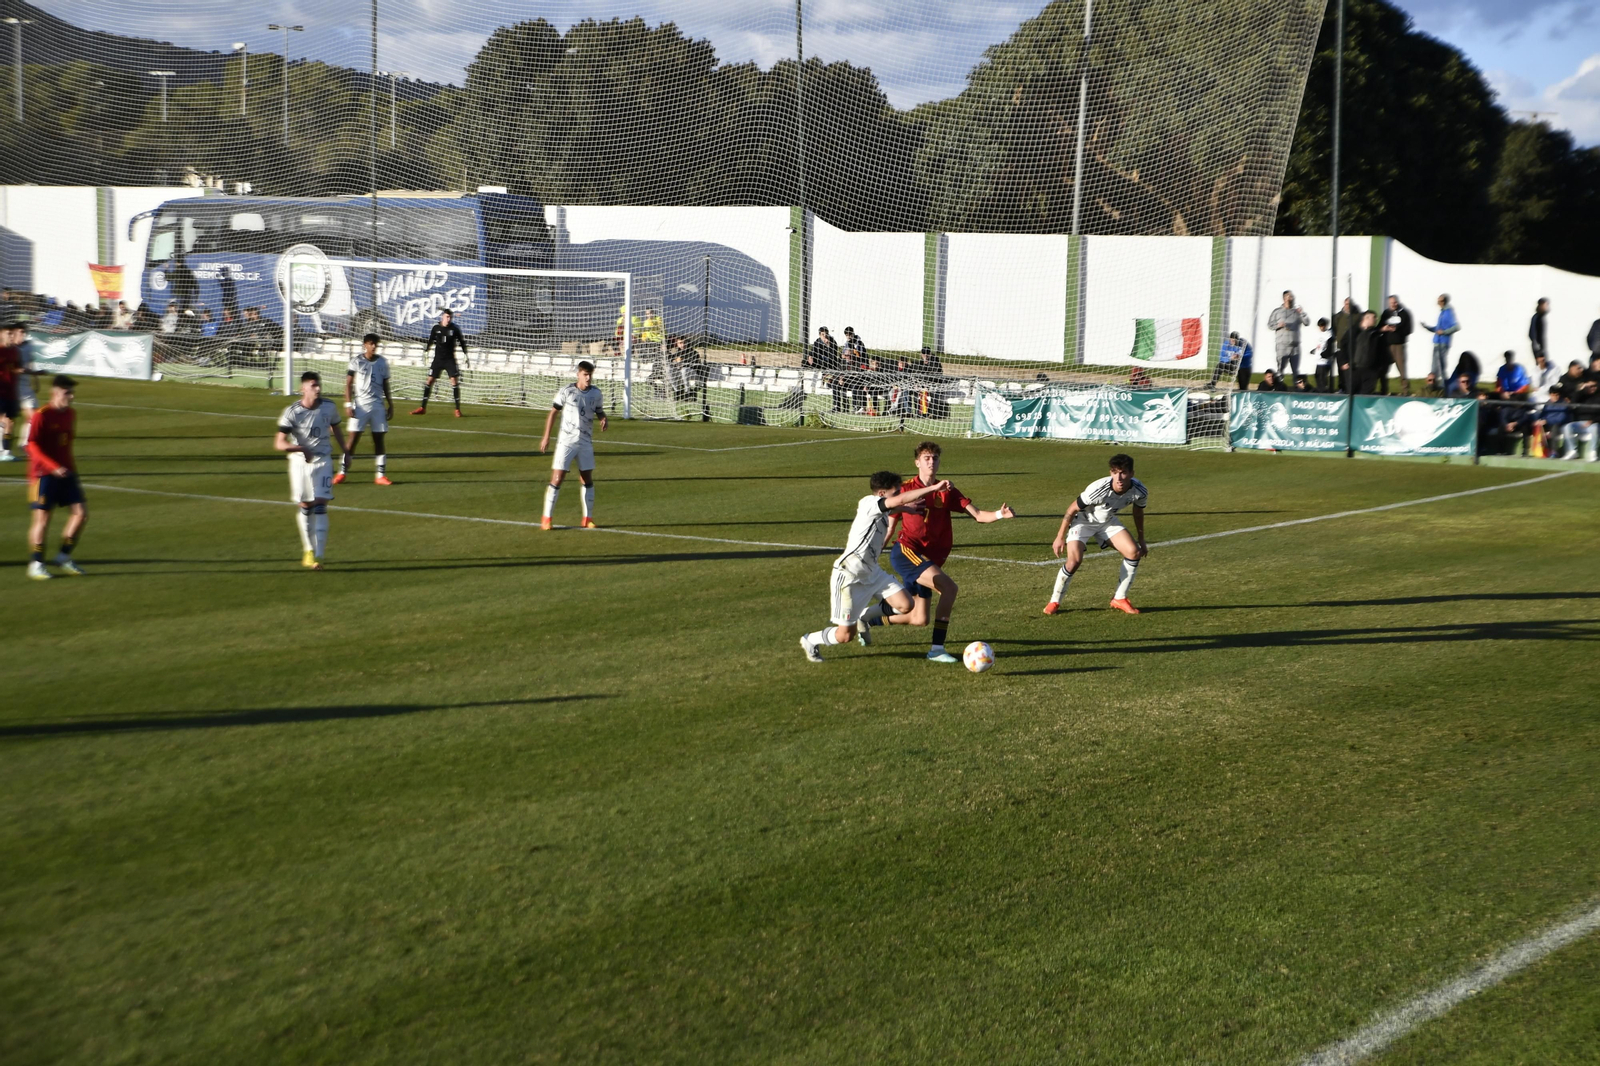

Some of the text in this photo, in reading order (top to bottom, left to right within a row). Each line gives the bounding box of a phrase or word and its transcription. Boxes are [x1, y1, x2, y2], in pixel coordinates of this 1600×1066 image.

[396, 285, 477, 326] VERDES!
[1292, 400, 1315, 409] PACO
[580, 406, 586, 416] 6
[1060, 412, 1070, 420] 04
[1100, 414, 1110, 422] 89
[1113, 415, 1124, 423] 26
[310, 426, 320, 437] 10
[1306, 440, 1335, 448] MÁLAGA
[322, 476, 332, 488] 10
[924, 507, 930, 523] 7
